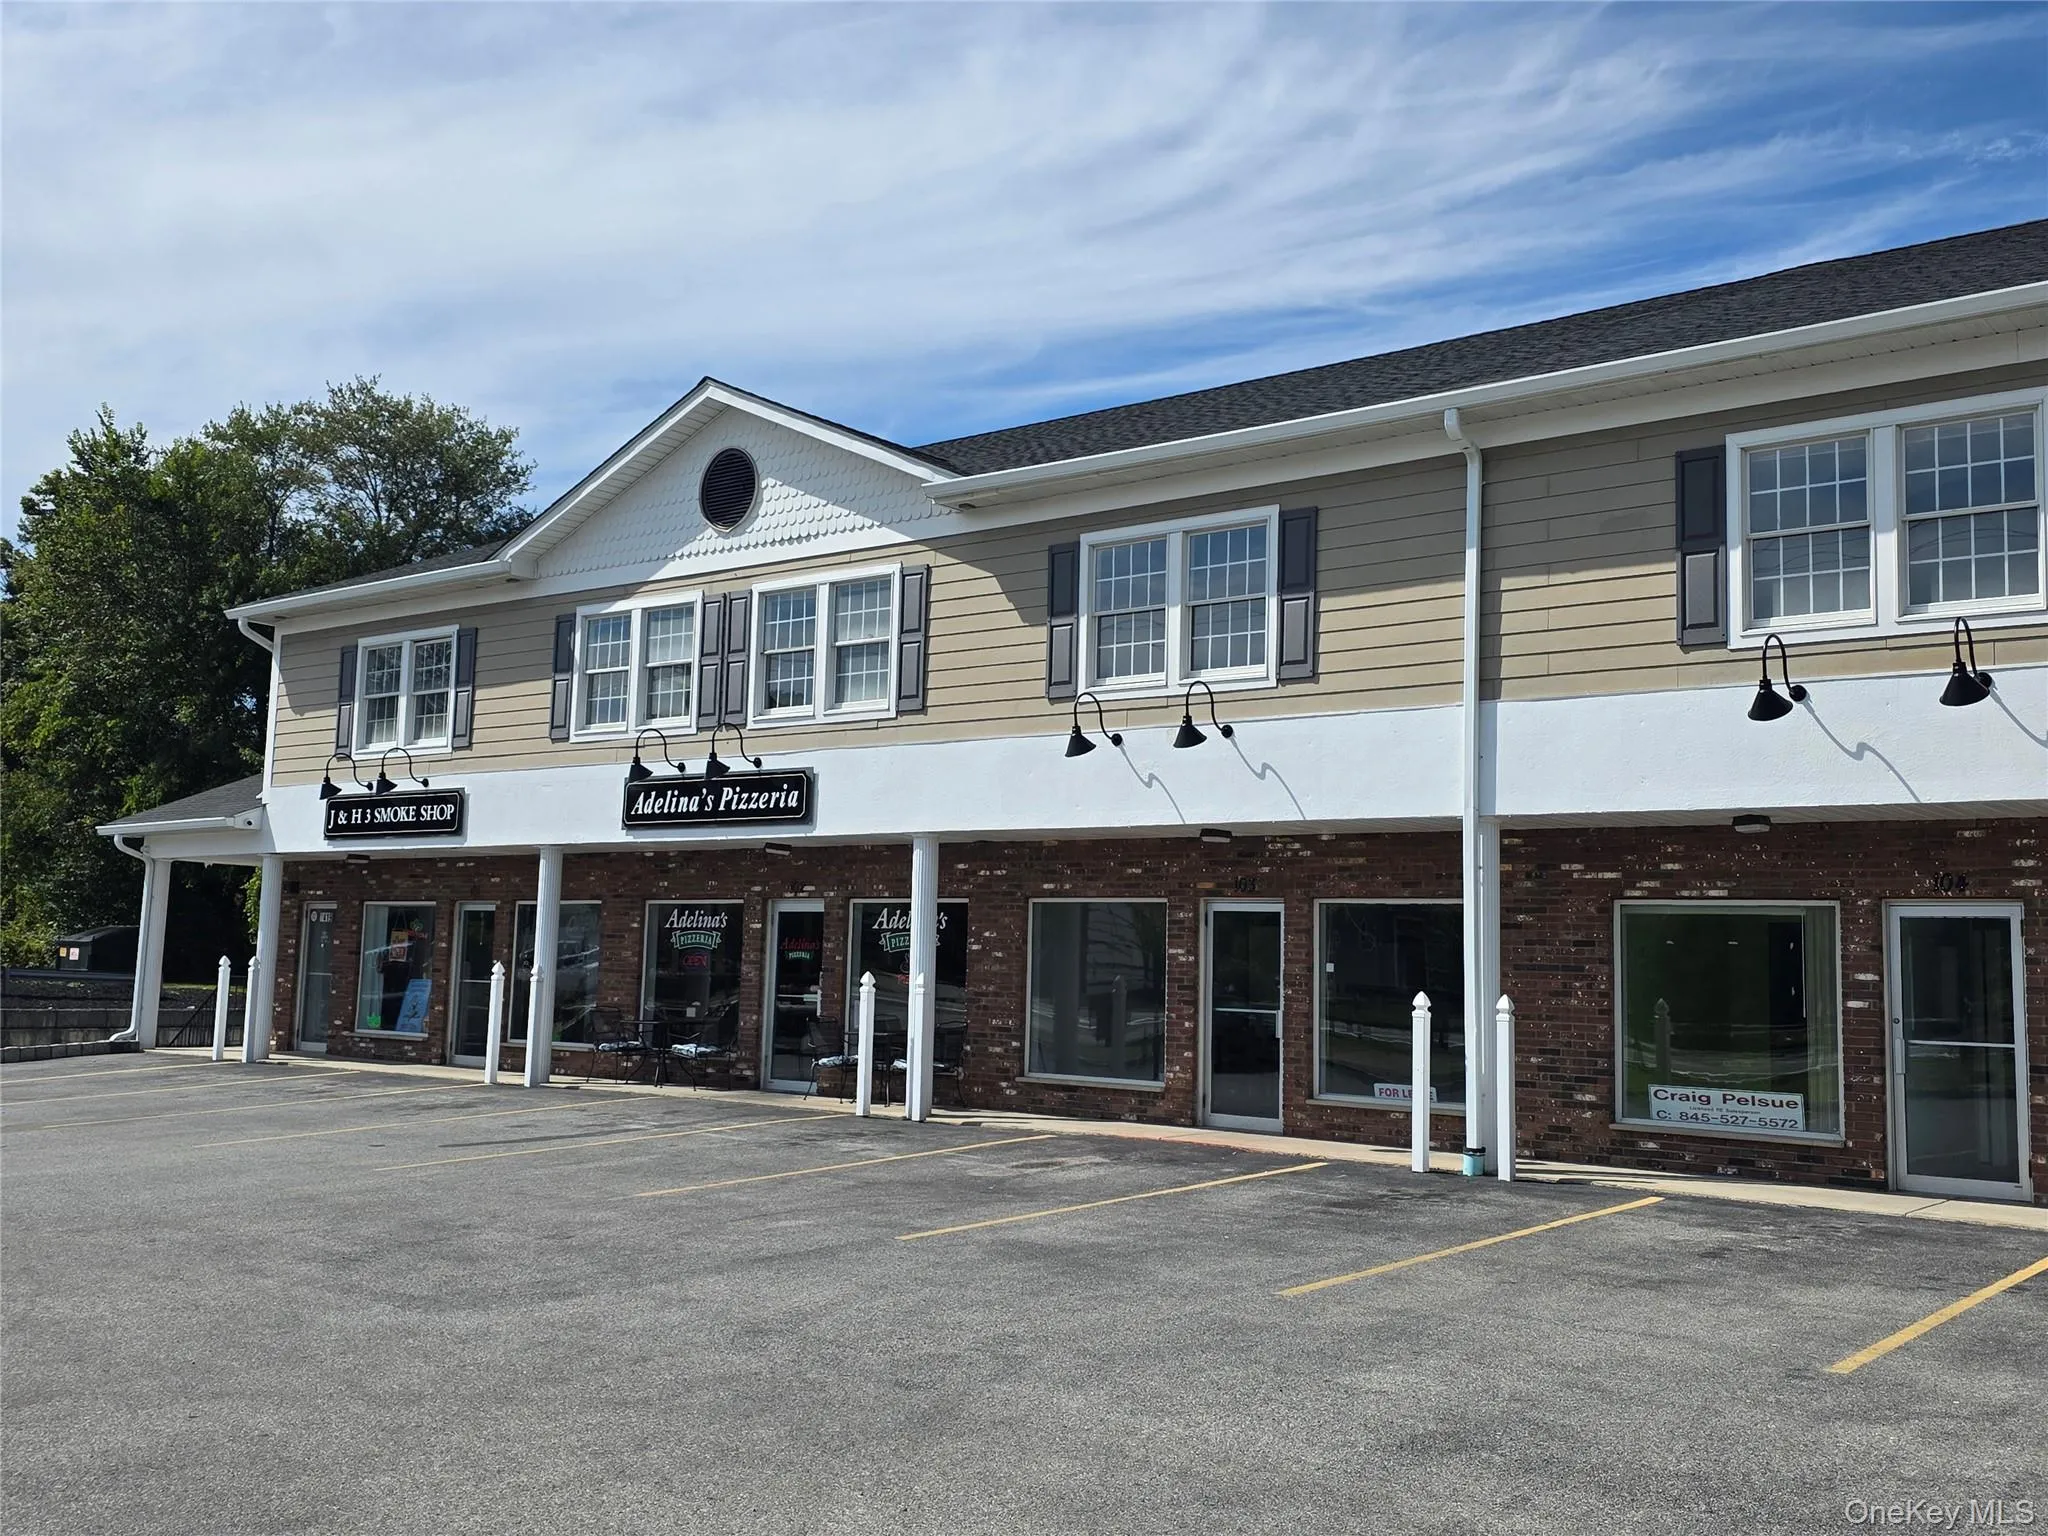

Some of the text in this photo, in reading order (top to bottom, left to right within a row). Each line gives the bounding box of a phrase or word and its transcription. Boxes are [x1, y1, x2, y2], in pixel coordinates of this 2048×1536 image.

[631, 783, 800, 815] Adelina's Pizzeria
[328, 803, 455, 829] J & H 3 SMOKE SHOP
[664, 908, 728, 929] Adelina's
[871, 907, 948, 930] Adel's
[680, 934, 713, 945] PIZZERIA
[1379, 1087, 1399, 1098] FOR
[1653, 1089, 1799, 1109] Craig Pelsue
[1656, 1110, 1799, 1129] C: 845-527-5572
